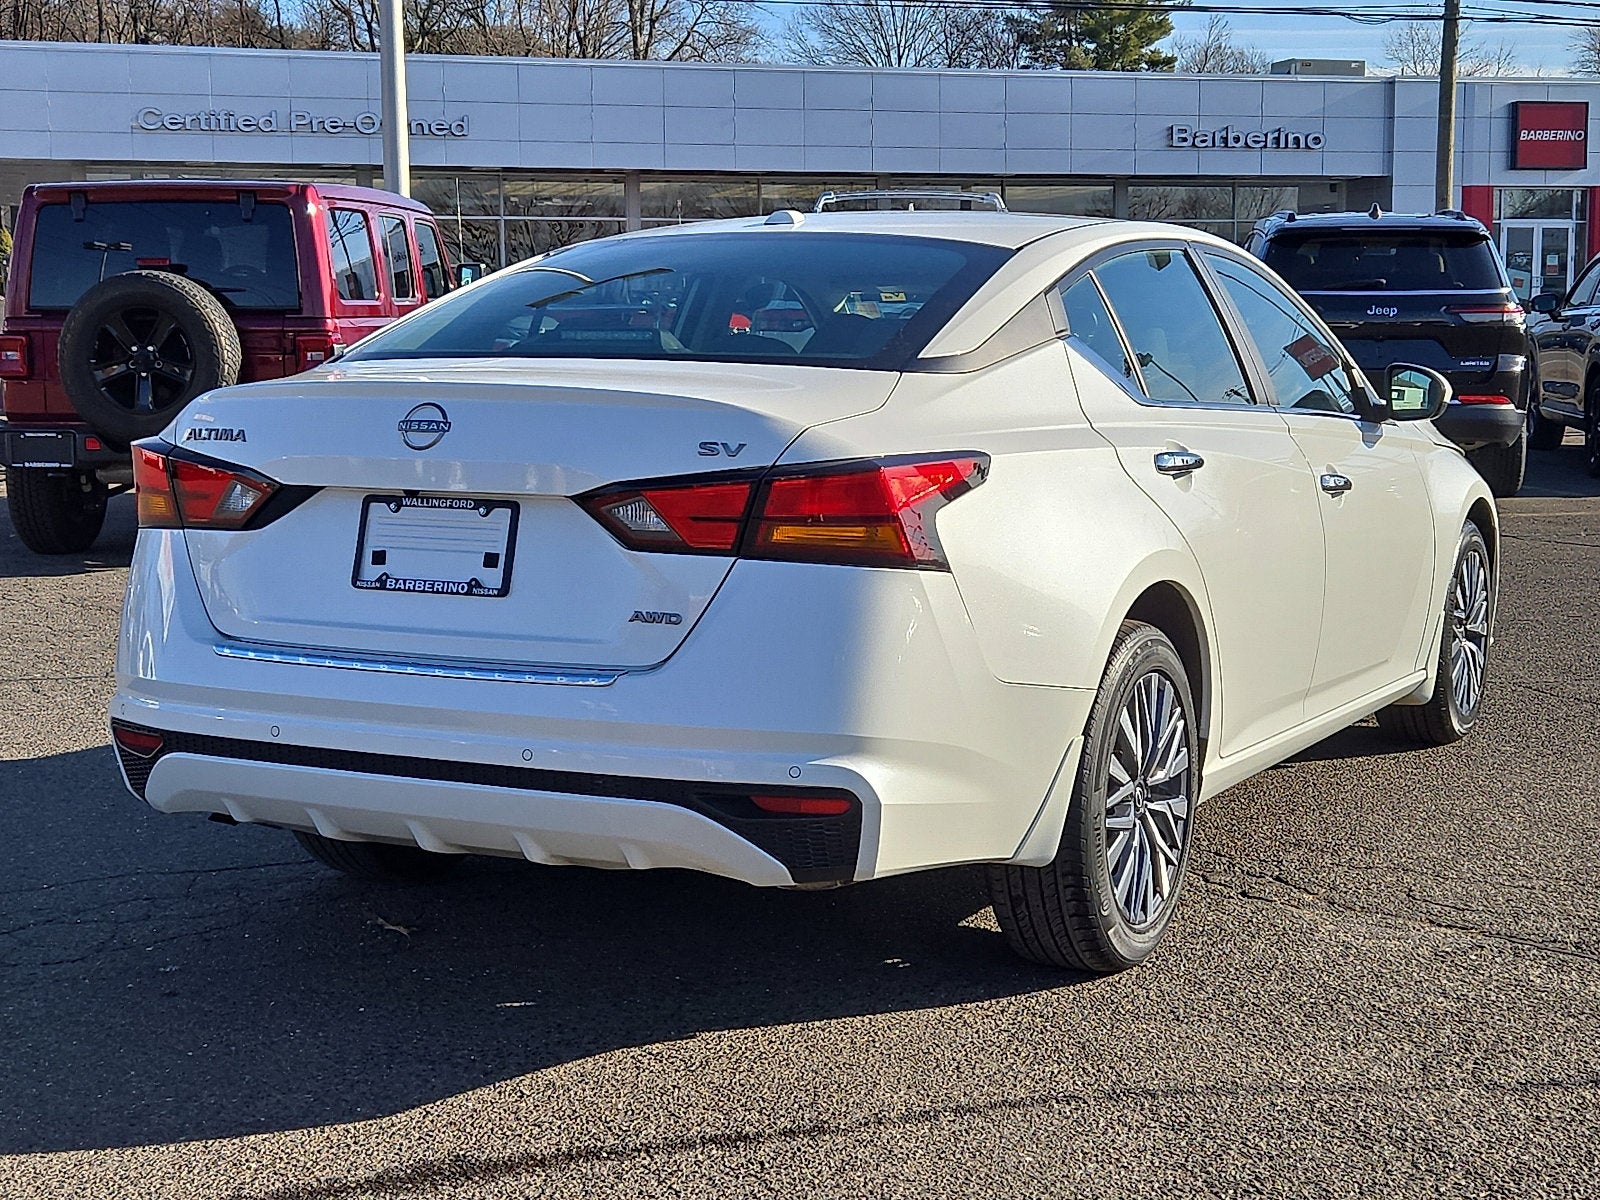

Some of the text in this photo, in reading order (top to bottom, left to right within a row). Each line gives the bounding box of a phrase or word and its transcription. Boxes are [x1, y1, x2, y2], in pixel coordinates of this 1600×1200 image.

[137, 107, 469, 137] Certified Pre-Oned
[1171, 123, 1327, 150] Barberino
[1519, 129, 1585, 141] BARBERINO
[1366, 305, 1398, 317] Jeep
[399, 421, 450, 431] NISSAN
[184, 427, 247, 443] ALTIMA
[697, 441, 748, 457] SV
[401, 497, 475, 509] WALLINGFORD
[355, 579, 499, 596] NISSAN BARBERINO NISSAN
[628, 610, 683, 626] AWD
